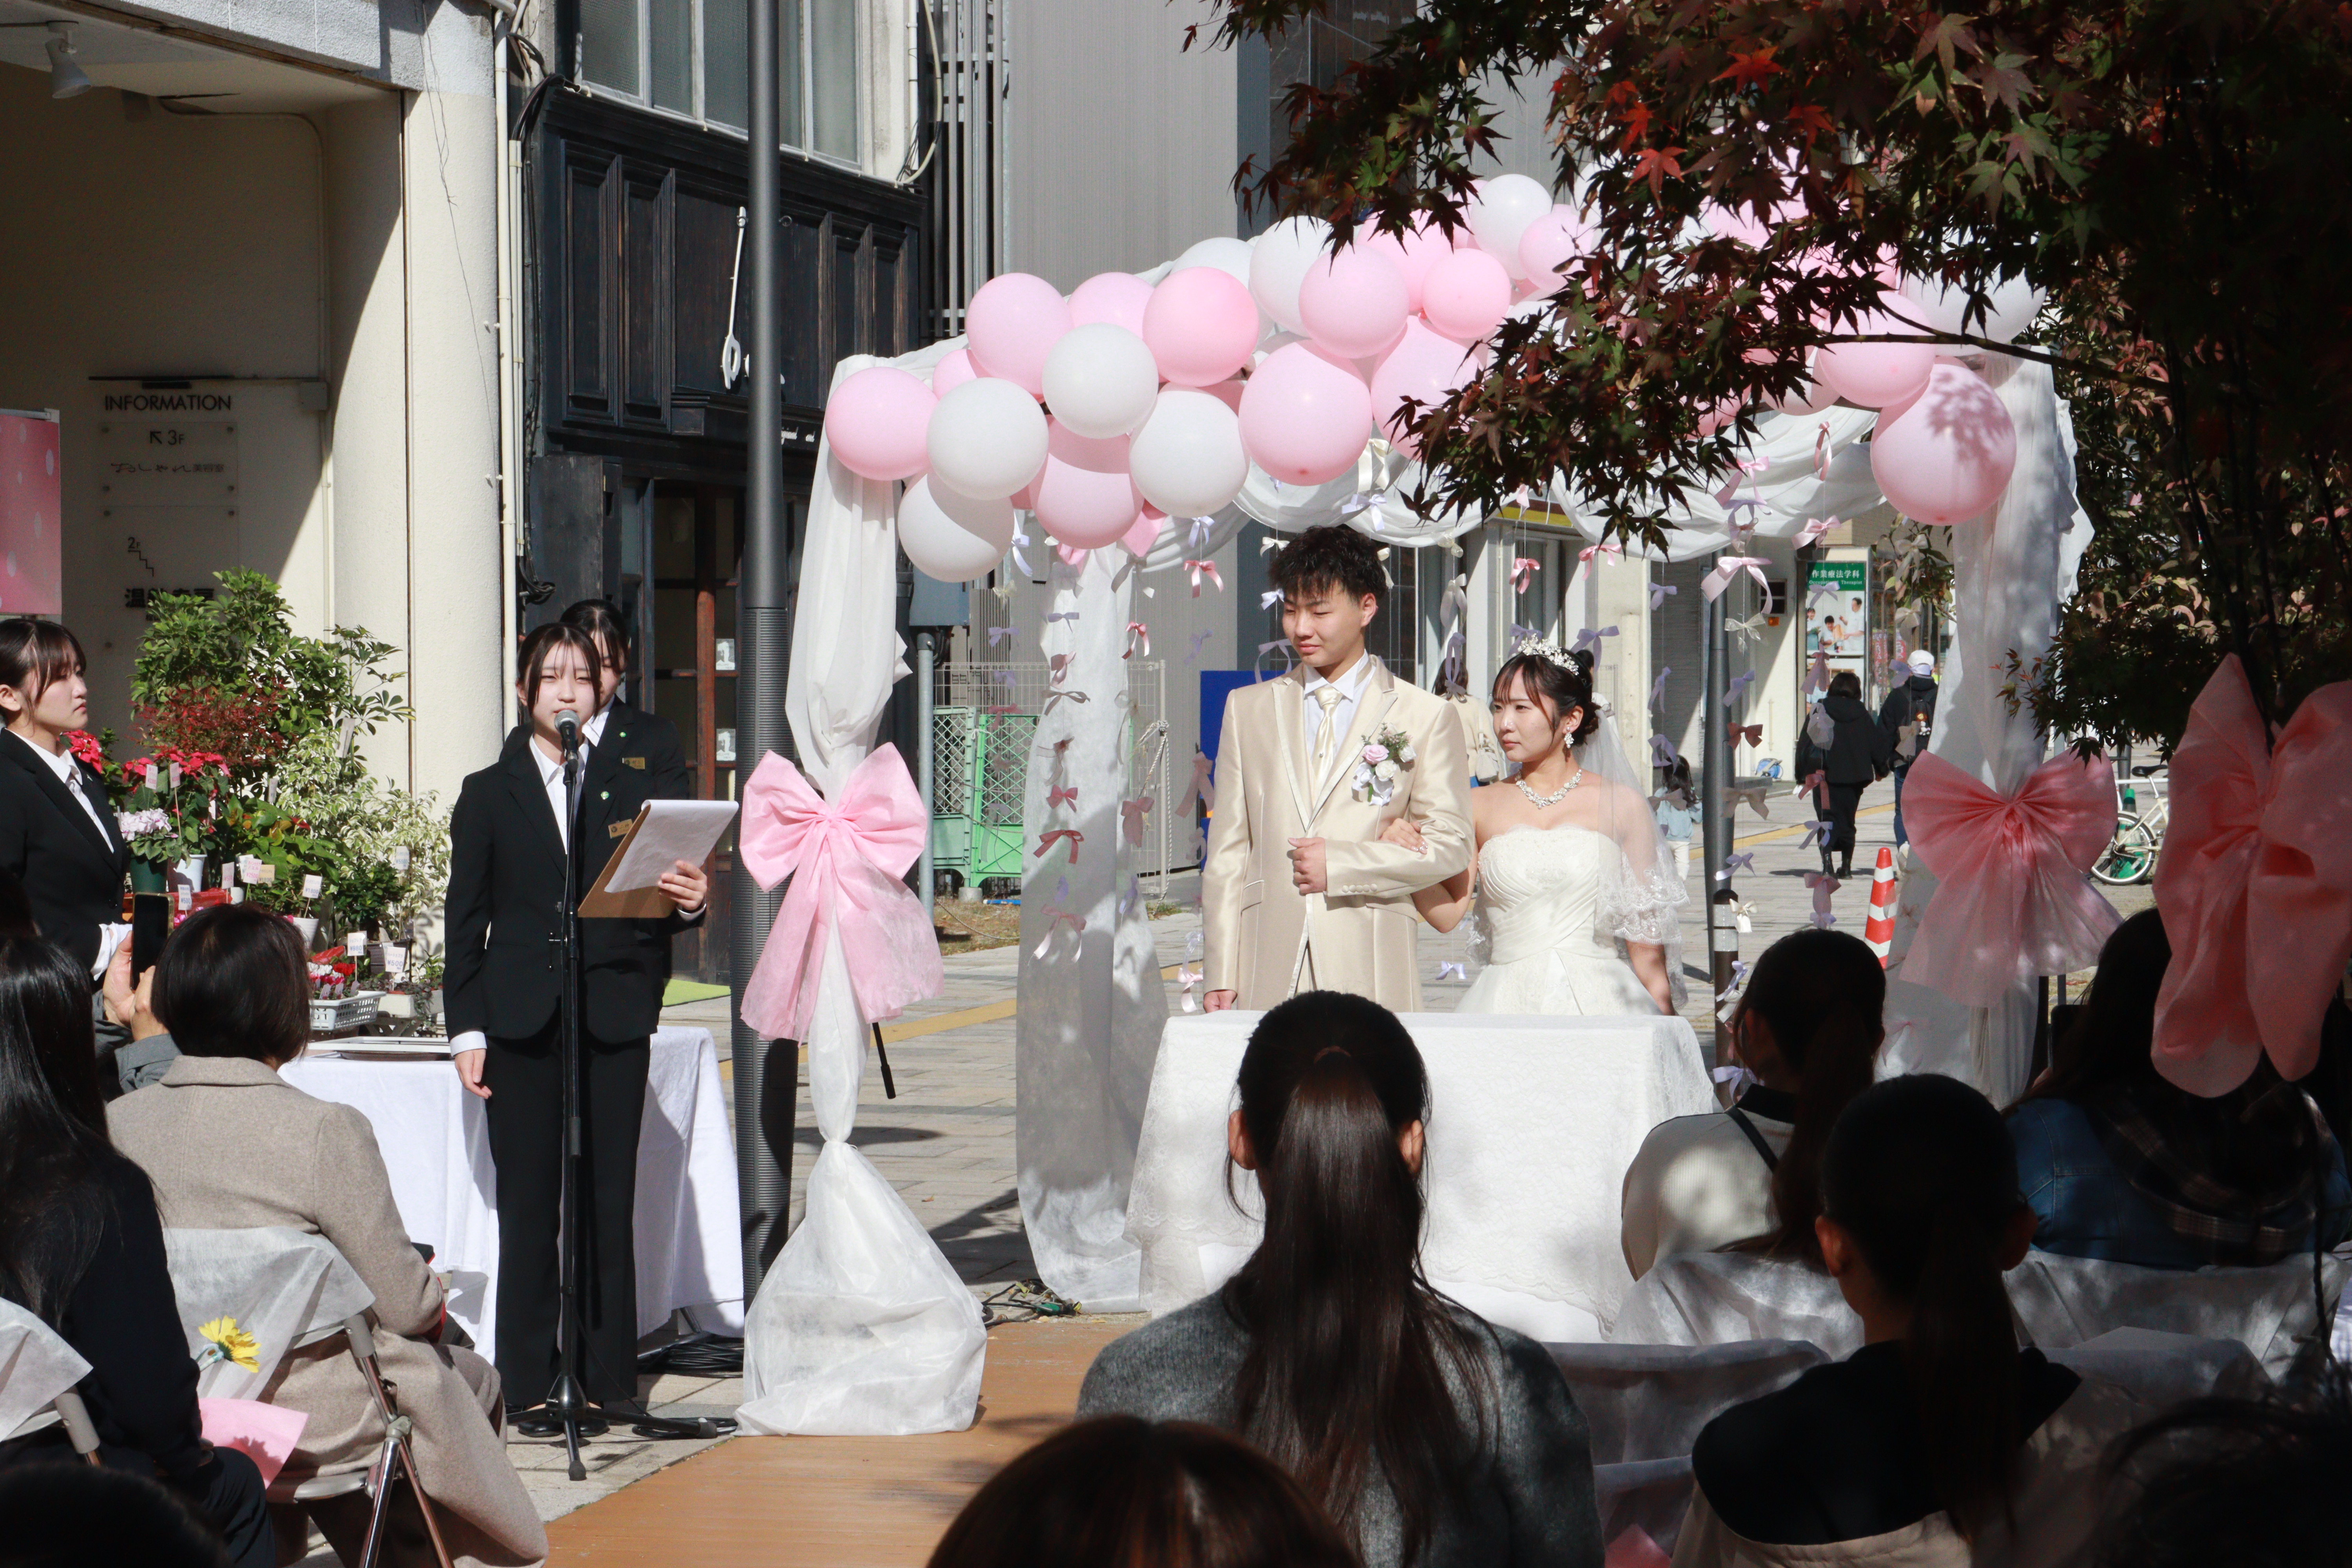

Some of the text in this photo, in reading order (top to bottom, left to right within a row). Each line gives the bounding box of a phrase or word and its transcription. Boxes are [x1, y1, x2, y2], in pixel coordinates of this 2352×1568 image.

[105, 395, 231, 411] INFORMATION
[168, 430, 184, 445] 3F
[128, 537, 140, 549] 2F
[1812, 570, 1860, 578] 作業療法学科
